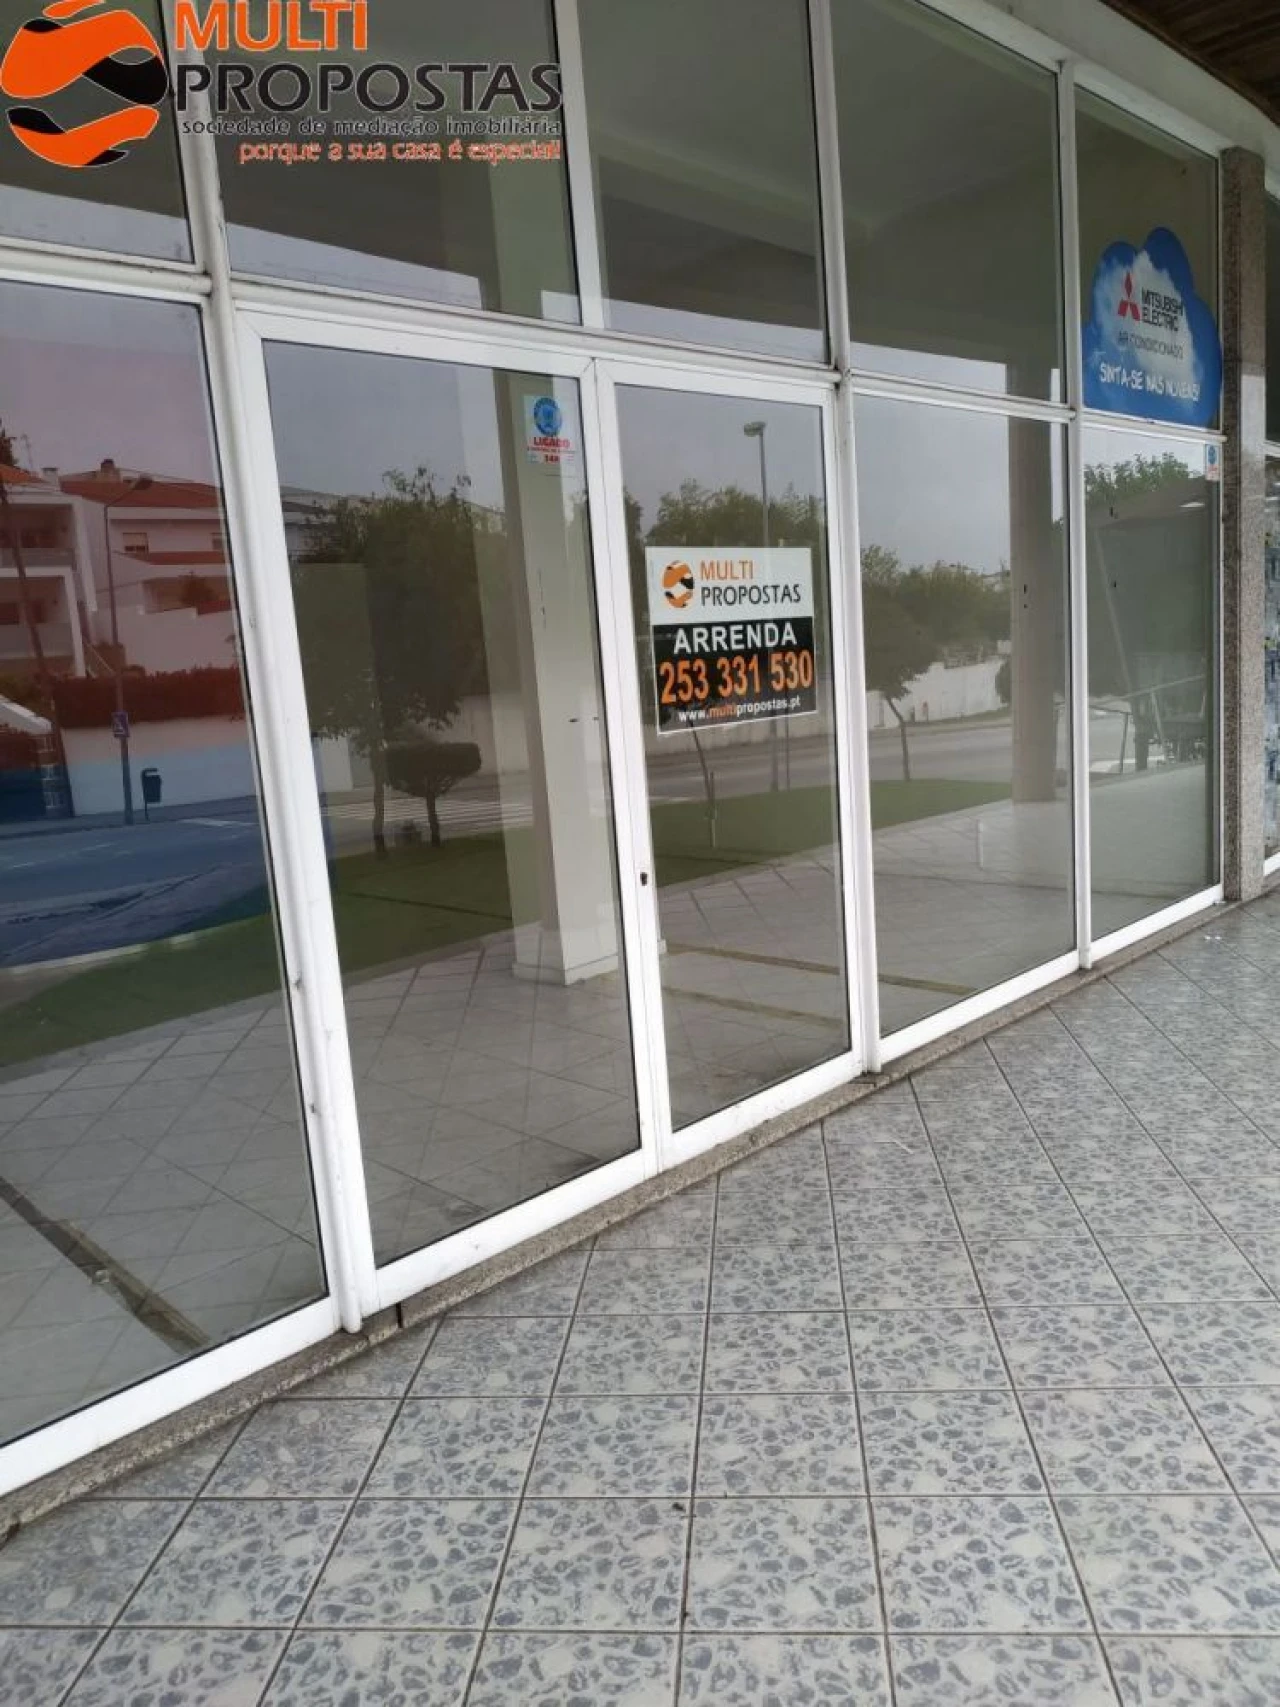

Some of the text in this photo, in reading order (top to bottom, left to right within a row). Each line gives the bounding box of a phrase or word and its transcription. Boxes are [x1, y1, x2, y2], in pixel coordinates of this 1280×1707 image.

[1142, 287, 1183, 316] MITSUBISHI
[1142, 306, 1179, 331] ELECTRIC
[1100, 361, 1144, 390] SINTA-SE
[700, 559, 754, 580] MULTI
[701, 583, 802, 606] PROPOSTAS
[673, 621, 797, 654] ARRENDA
[659, 649, 813, 704] 253 331 530
[678, 695, 801, 723] www.multipropostas.pt
